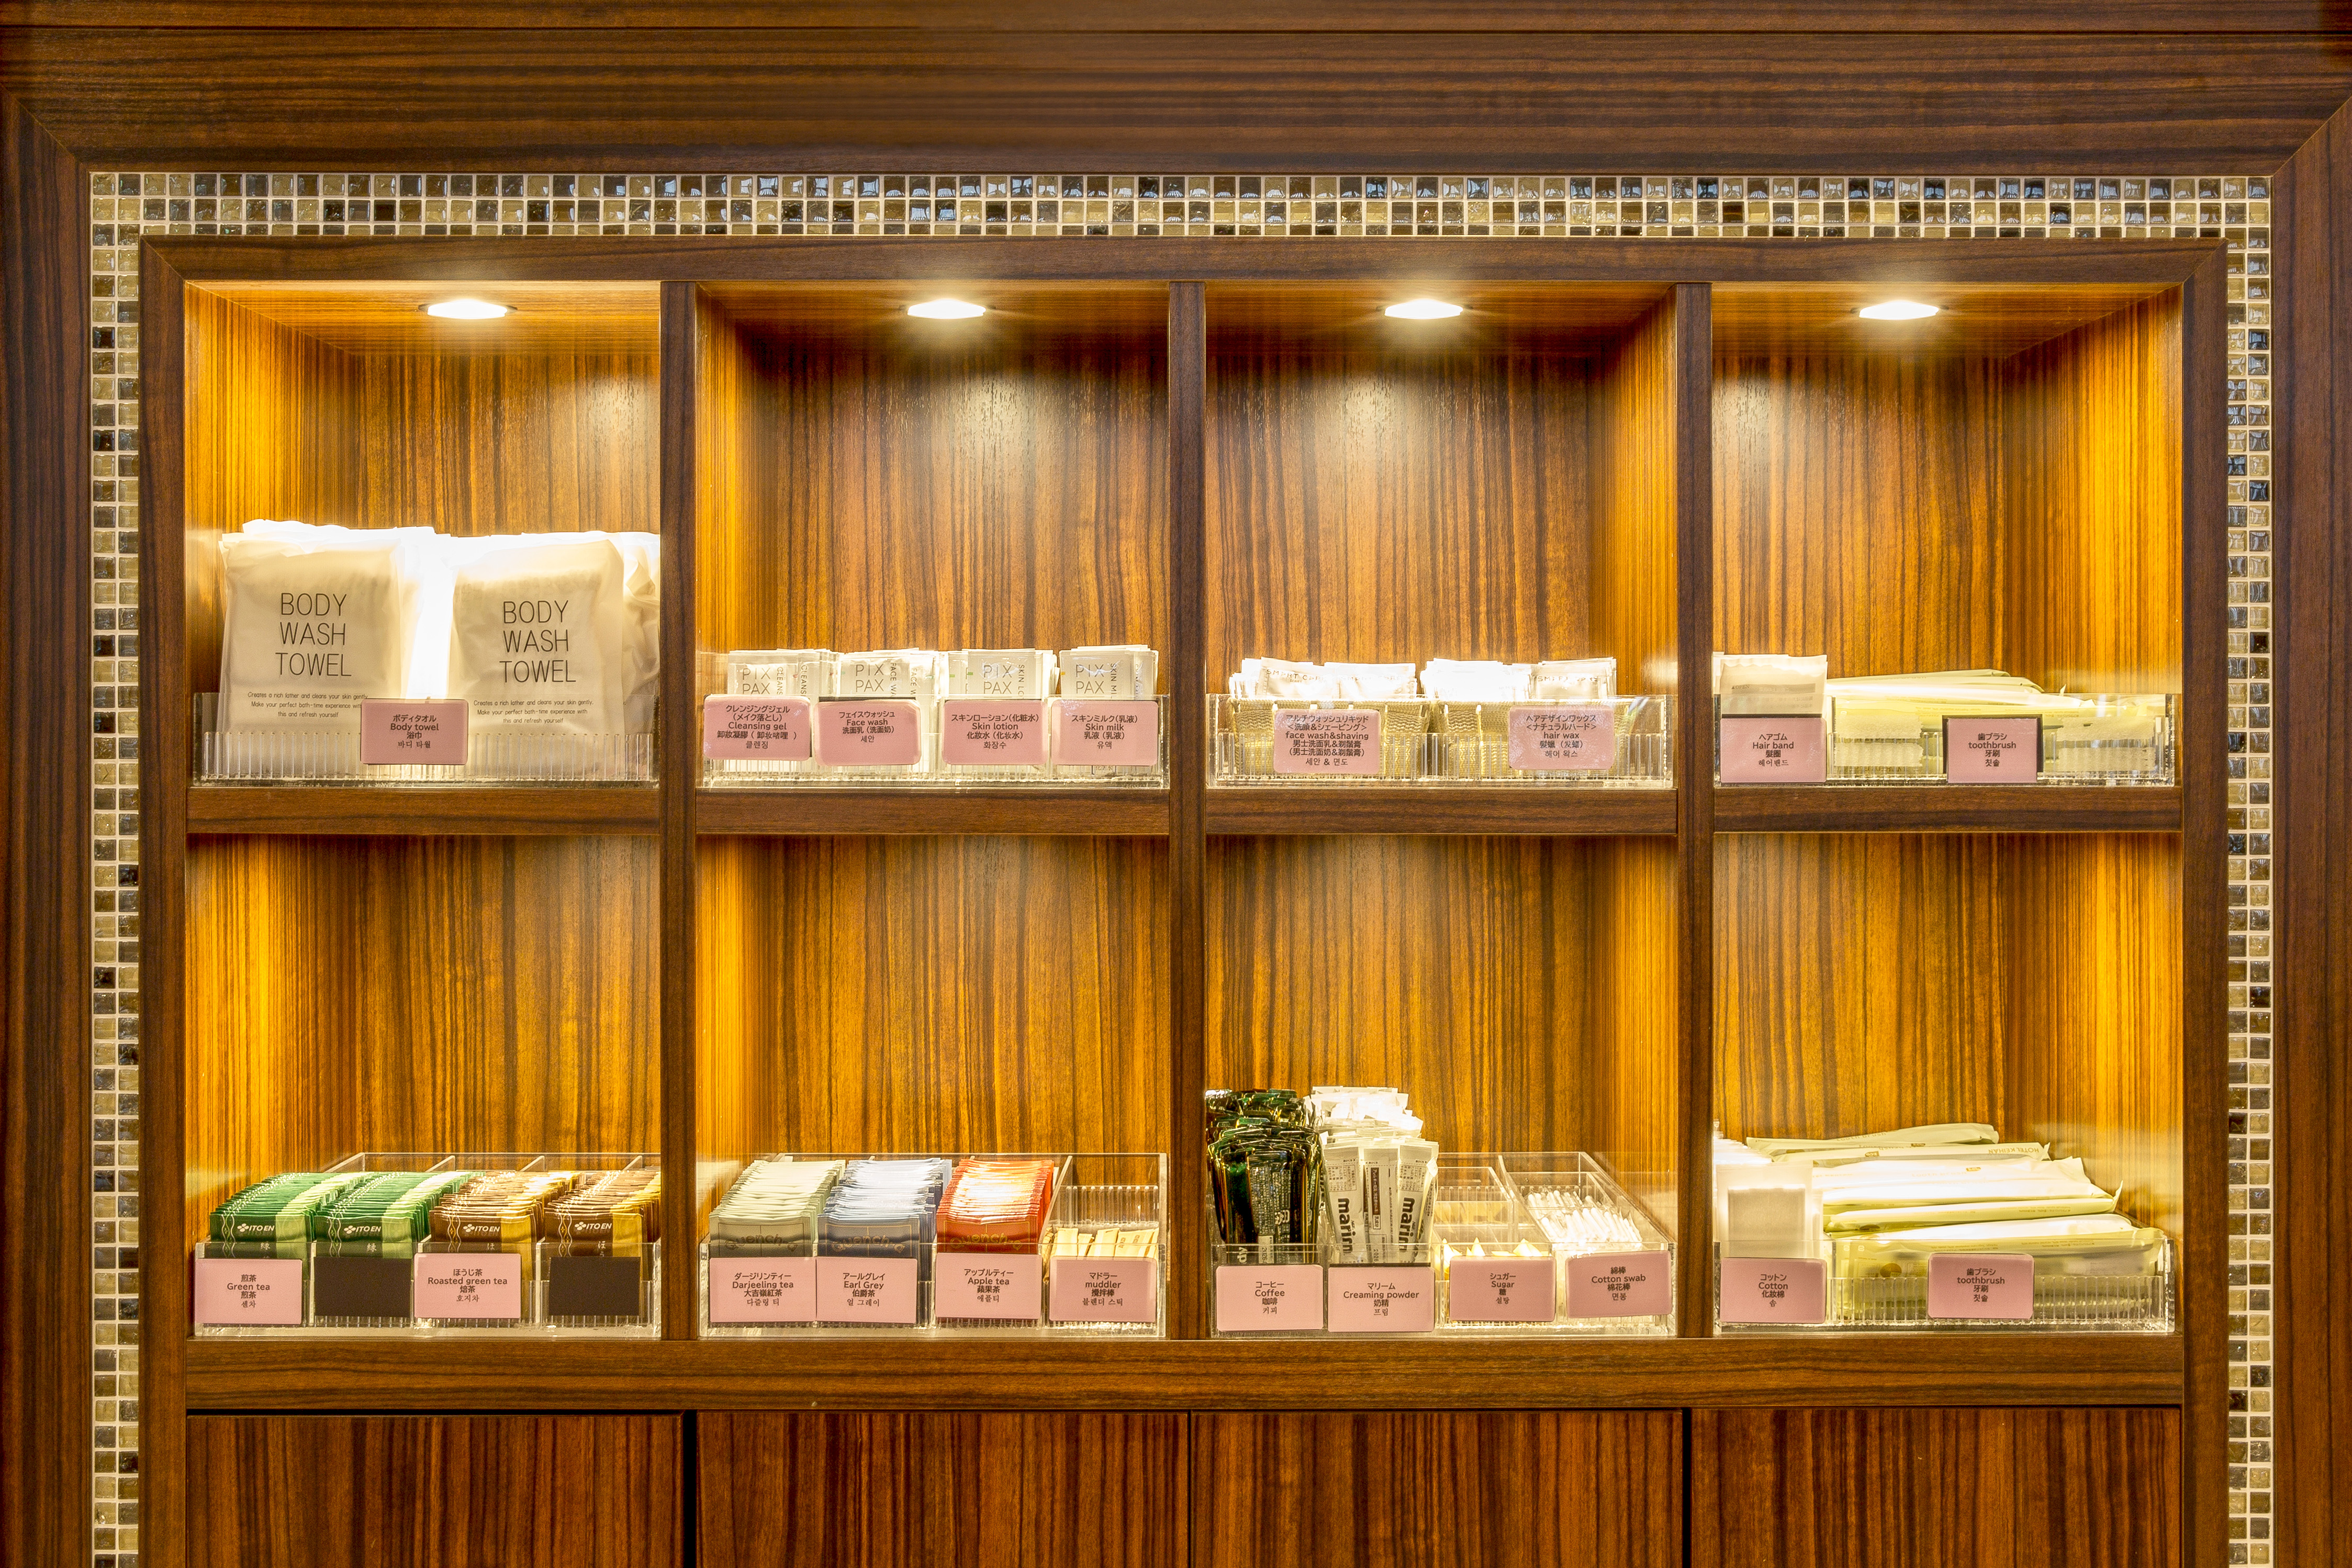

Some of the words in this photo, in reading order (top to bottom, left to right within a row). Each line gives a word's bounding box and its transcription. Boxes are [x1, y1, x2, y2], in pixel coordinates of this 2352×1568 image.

[281, 593, 346, 616] BODY
[503, 600, 568, 624] BODY
[280, 622, 345, 645] WASH
[503, 630, 568, 653] WASH
[275, 653, 351, 676] TOWEL
[856, 664, 884, 676] PIX
[1076, 664, 1105, 677] PIX
[499, 660, 576, 682] TOWEL
[742, 667, 770, 680] PIX
[983, 665, 1012, 678] PIX
[742, 683, 770, 695] PAX
[856, 679, 884, 692] PAX
[983, 681, 1012, 695] PAX
[1076, 681, 1105, 693] PAX
[733, 713, 782, 722] （メイク落とし）
[729, 722, 770, 730] Cleansing
[1545, 749, 1560, 758] 헤어
[733, 1281, 777, 1290] Darjeeling
[968, 1278, 992, 1286] Apple
[1492, 1281, 1514, 1290] Sugar
[1608, 1283, 1630, 1291] 棉花棒
[744, 1289, 782, 1297] 大吉嶺紅茶
